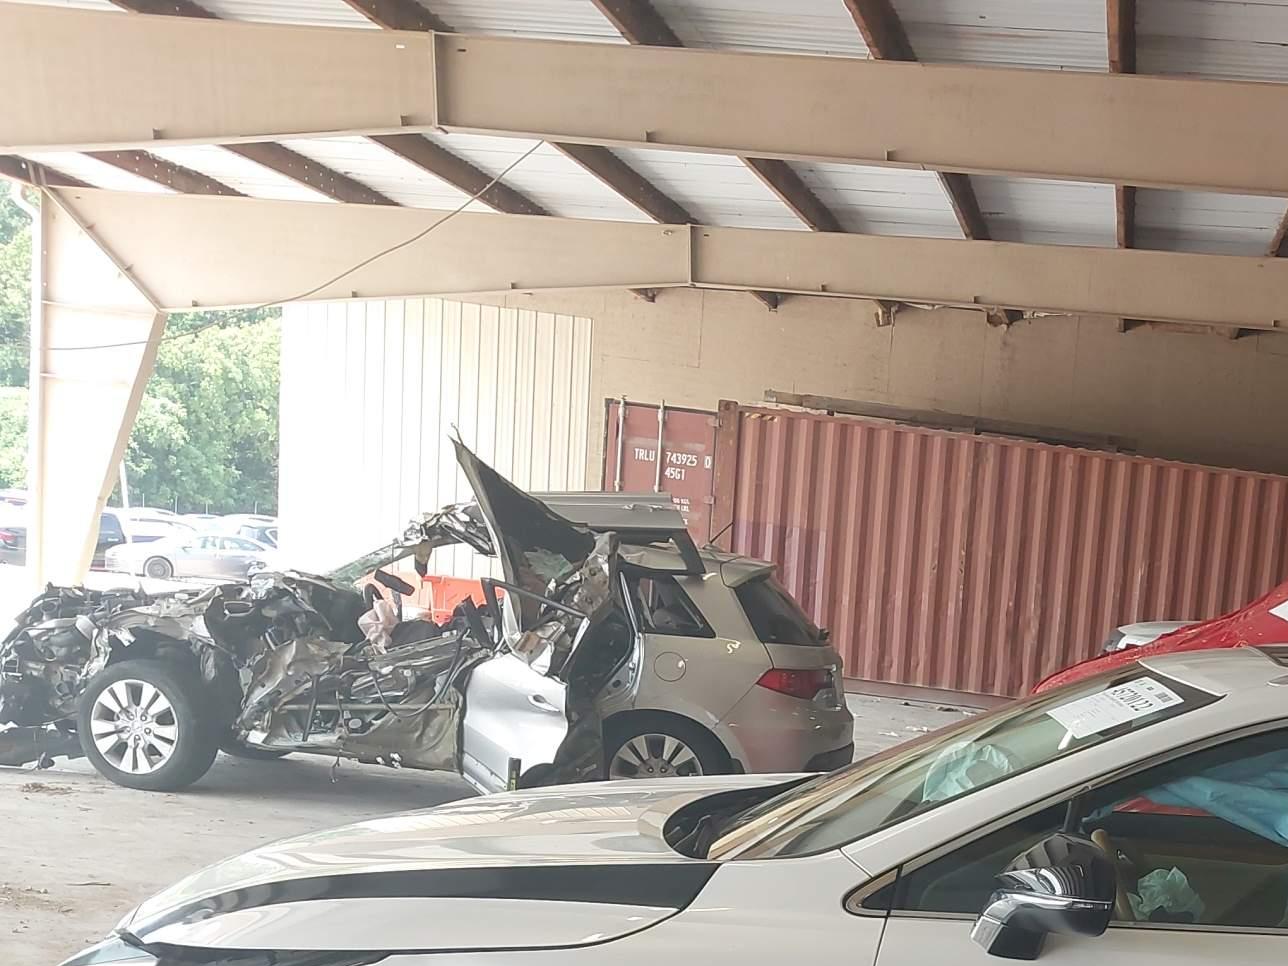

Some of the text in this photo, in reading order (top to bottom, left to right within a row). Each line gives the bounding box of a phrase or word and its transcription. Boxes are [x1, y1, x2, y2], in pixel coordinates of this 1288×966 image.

[634, 448, 656, 462] TRLU
[665, 452, 698, 467] 743925
[665, 467, 685, 481] 45G1
